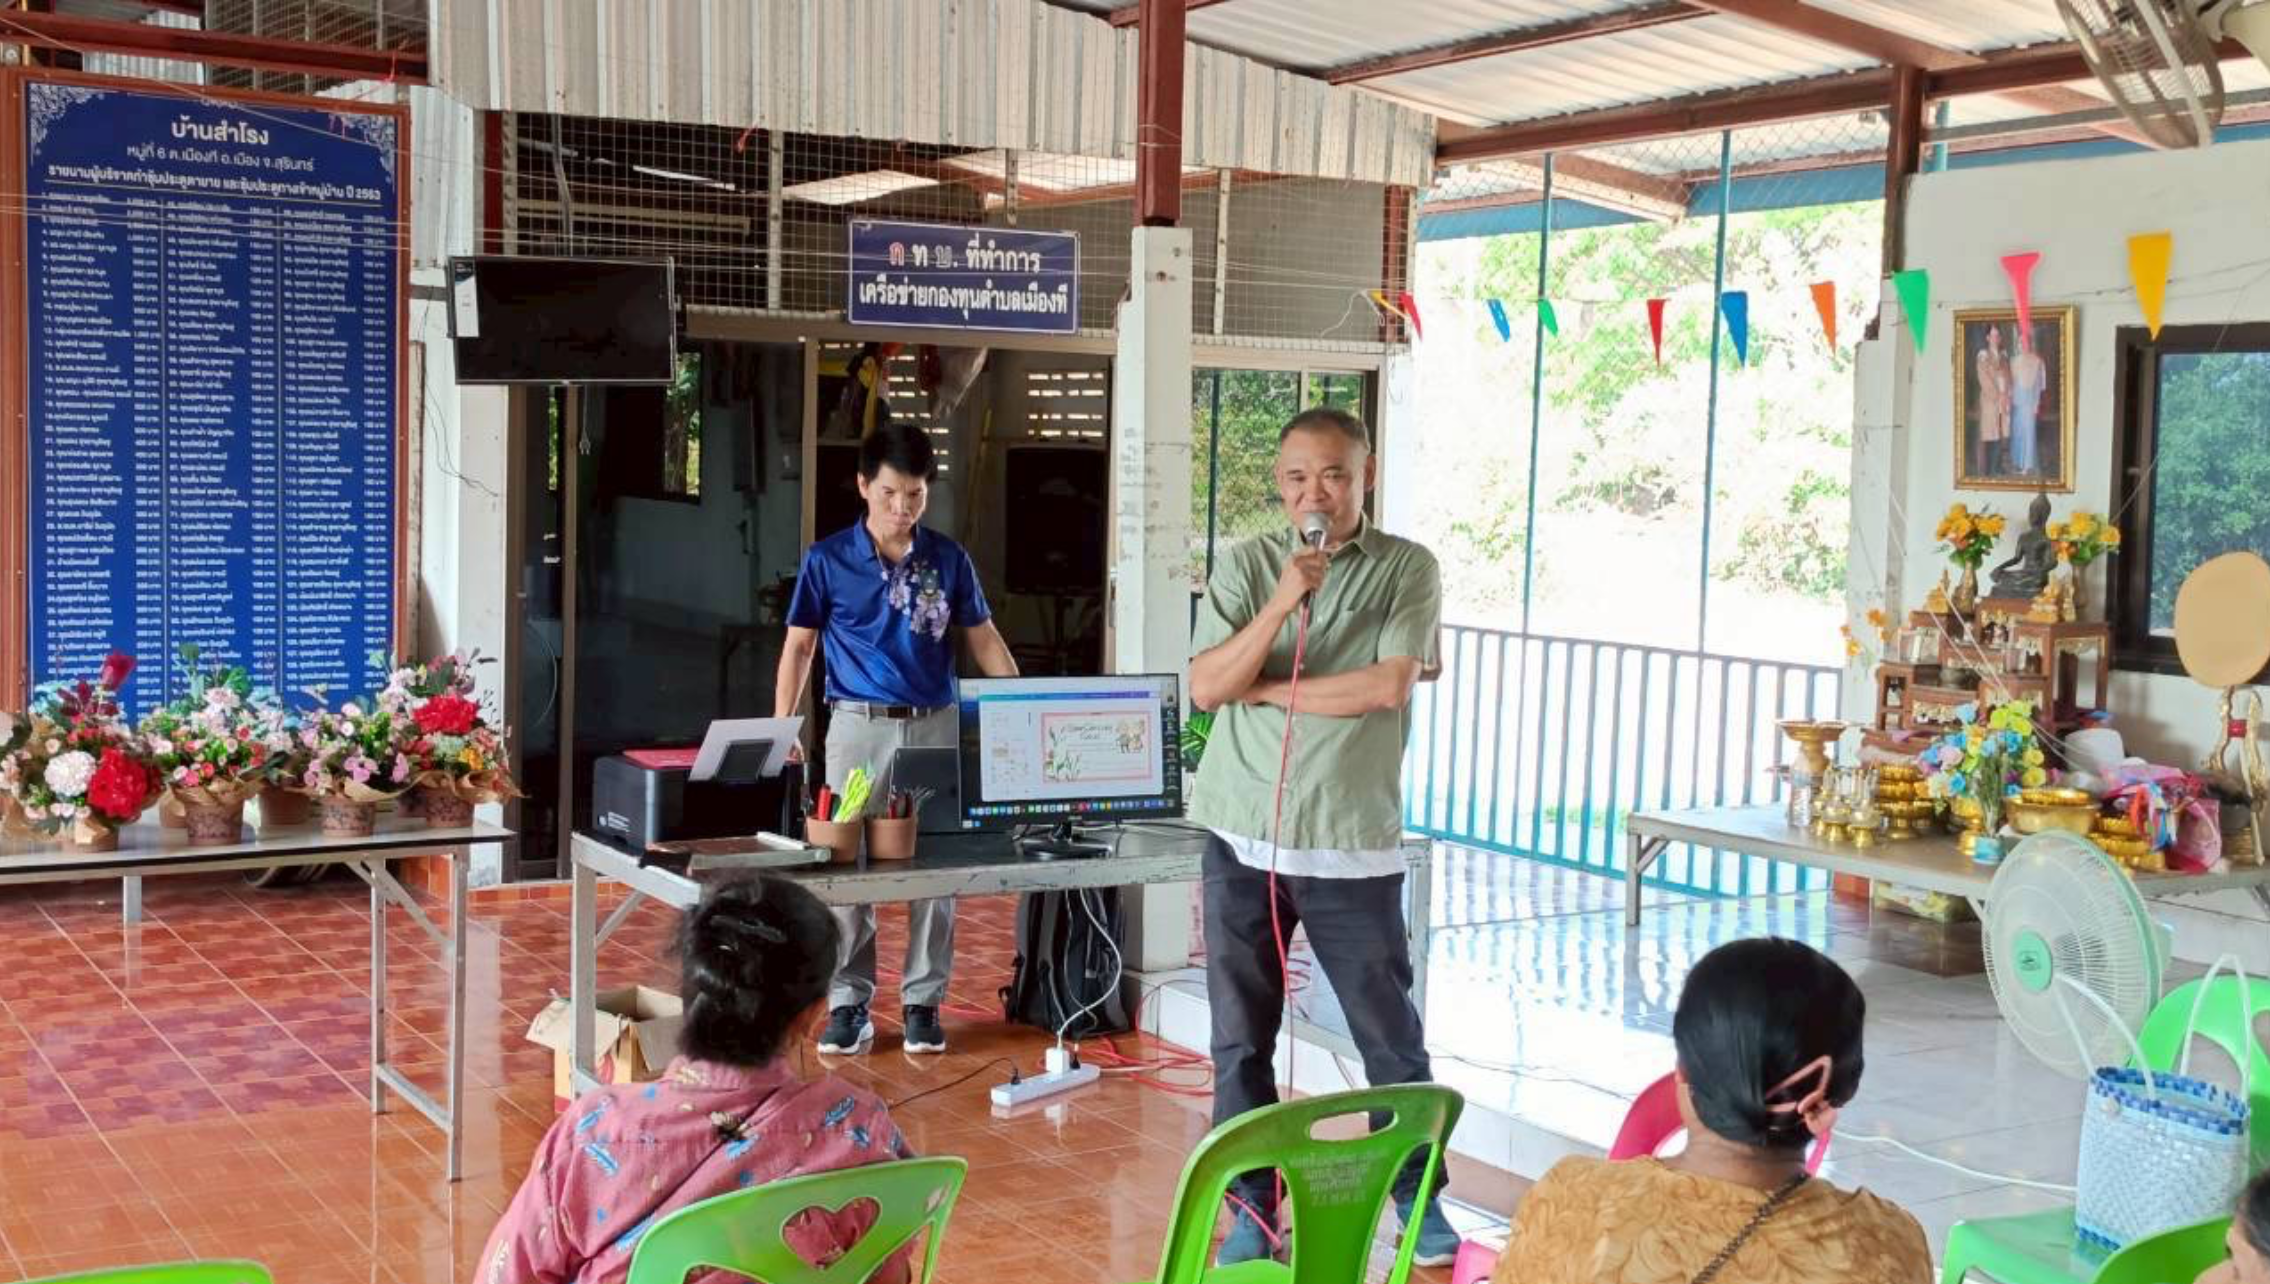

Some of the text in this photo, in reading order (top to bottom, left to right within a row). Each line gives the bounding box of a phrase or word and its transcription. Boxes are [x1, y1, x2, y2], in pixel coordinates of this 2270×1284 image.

[171, 114, 269, 145] บ้านสำโรง
[912, 243, 928, 267] ท
[966, 231, 1041, 273] ที่ทำการ
[859, 273, 1069, 320] เครือข่ายกองทุนตำบลเมืองที
